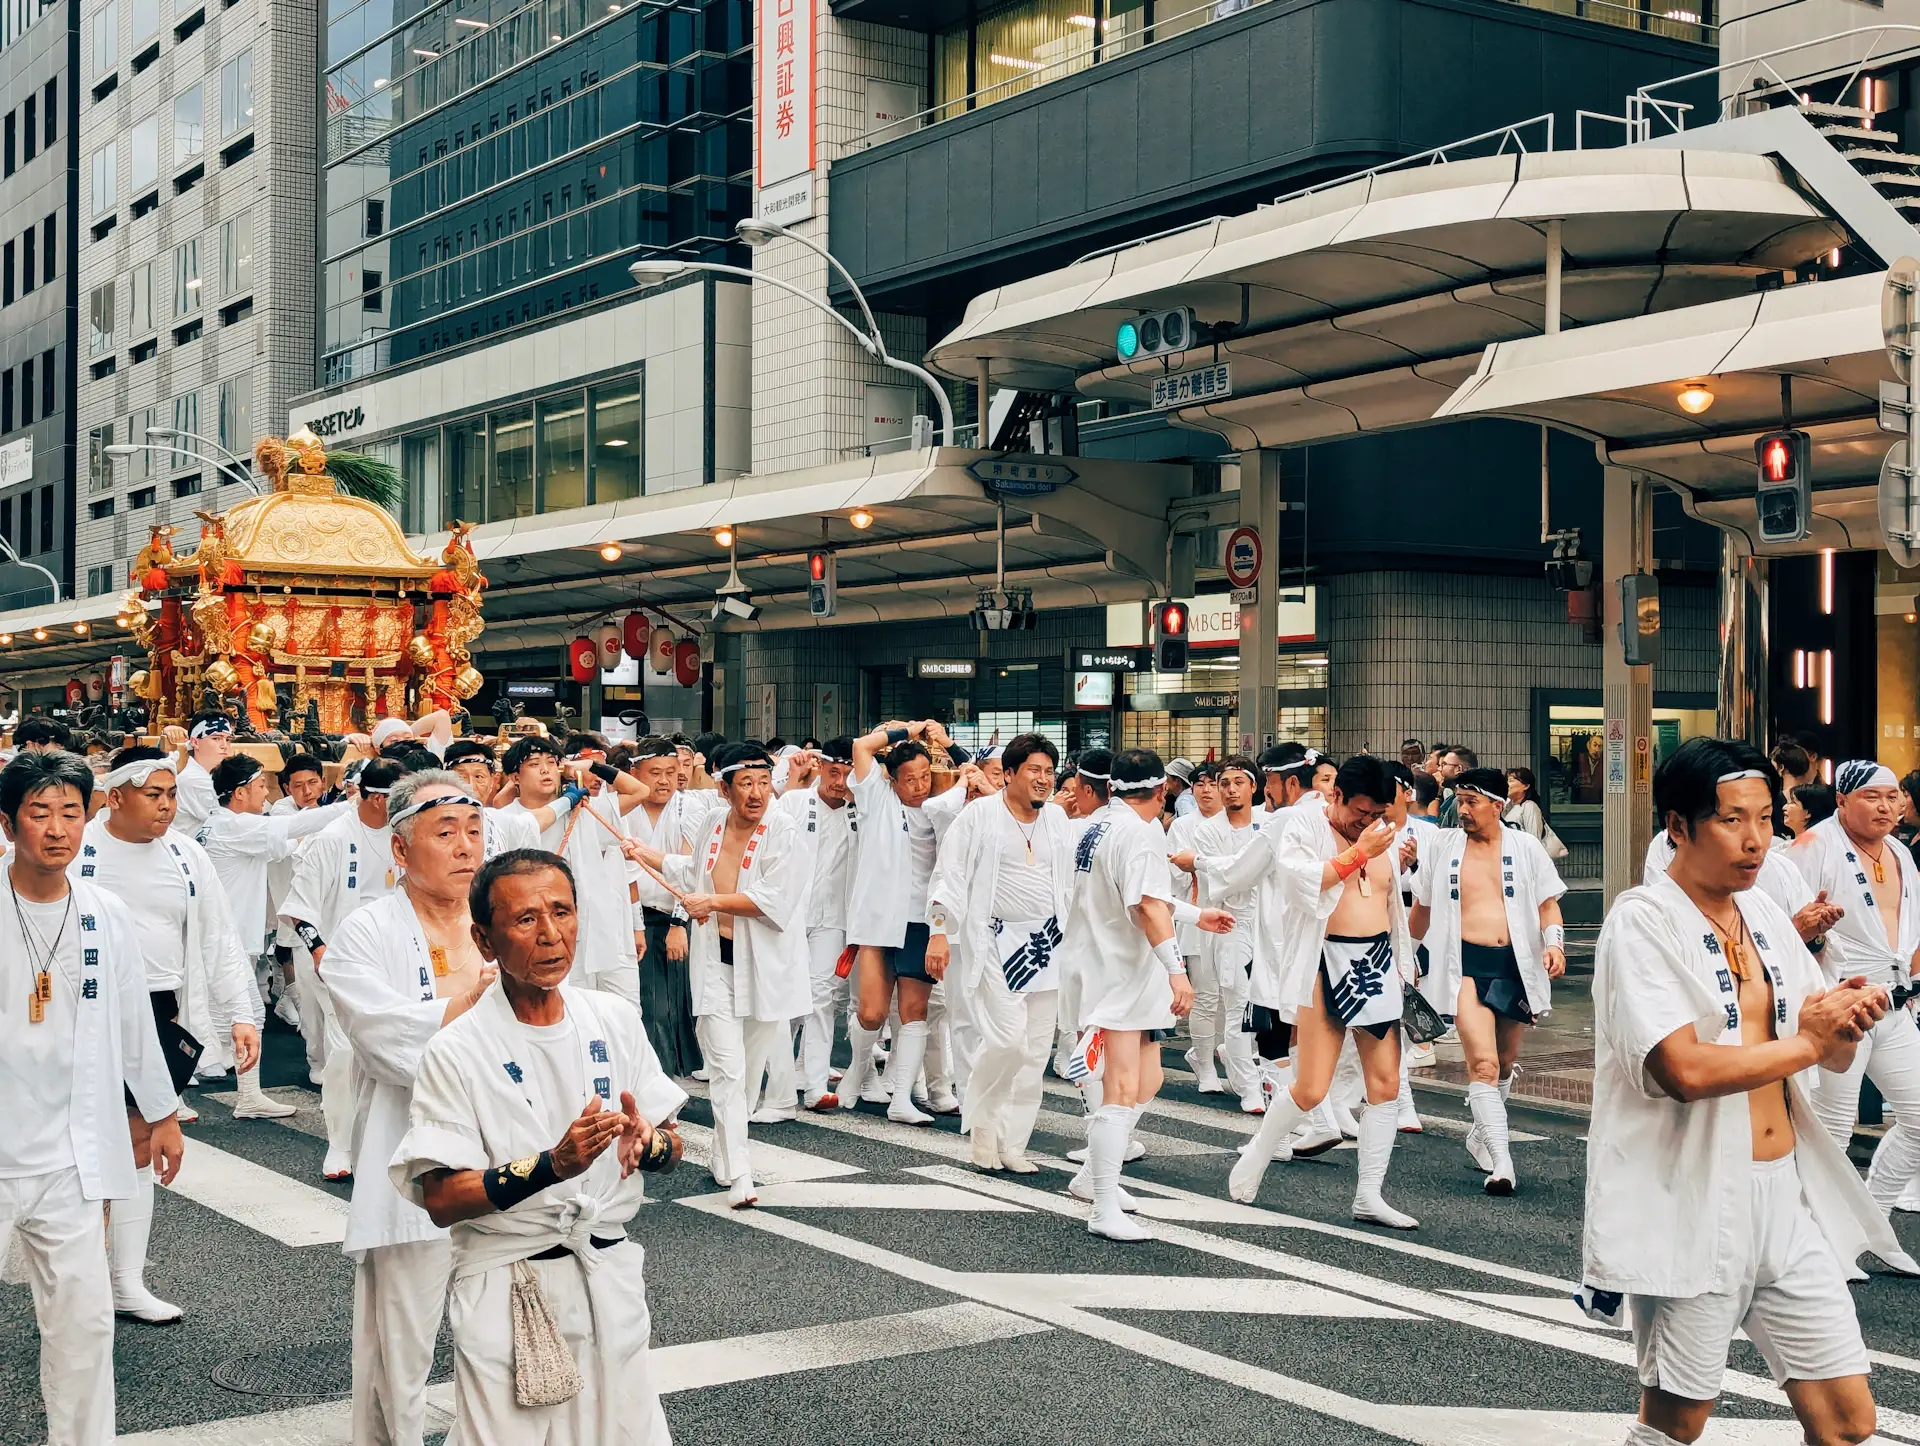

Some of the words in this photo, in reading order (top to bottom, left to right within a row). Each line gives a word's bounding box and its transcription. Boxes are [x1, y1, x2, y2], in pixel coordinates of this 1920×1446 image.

[1154, 367, 1228, 405] 歩車分離信号
[995, 479, 1036, 491] Sakaimachi
[1038, 483, 1052, 492] dori
